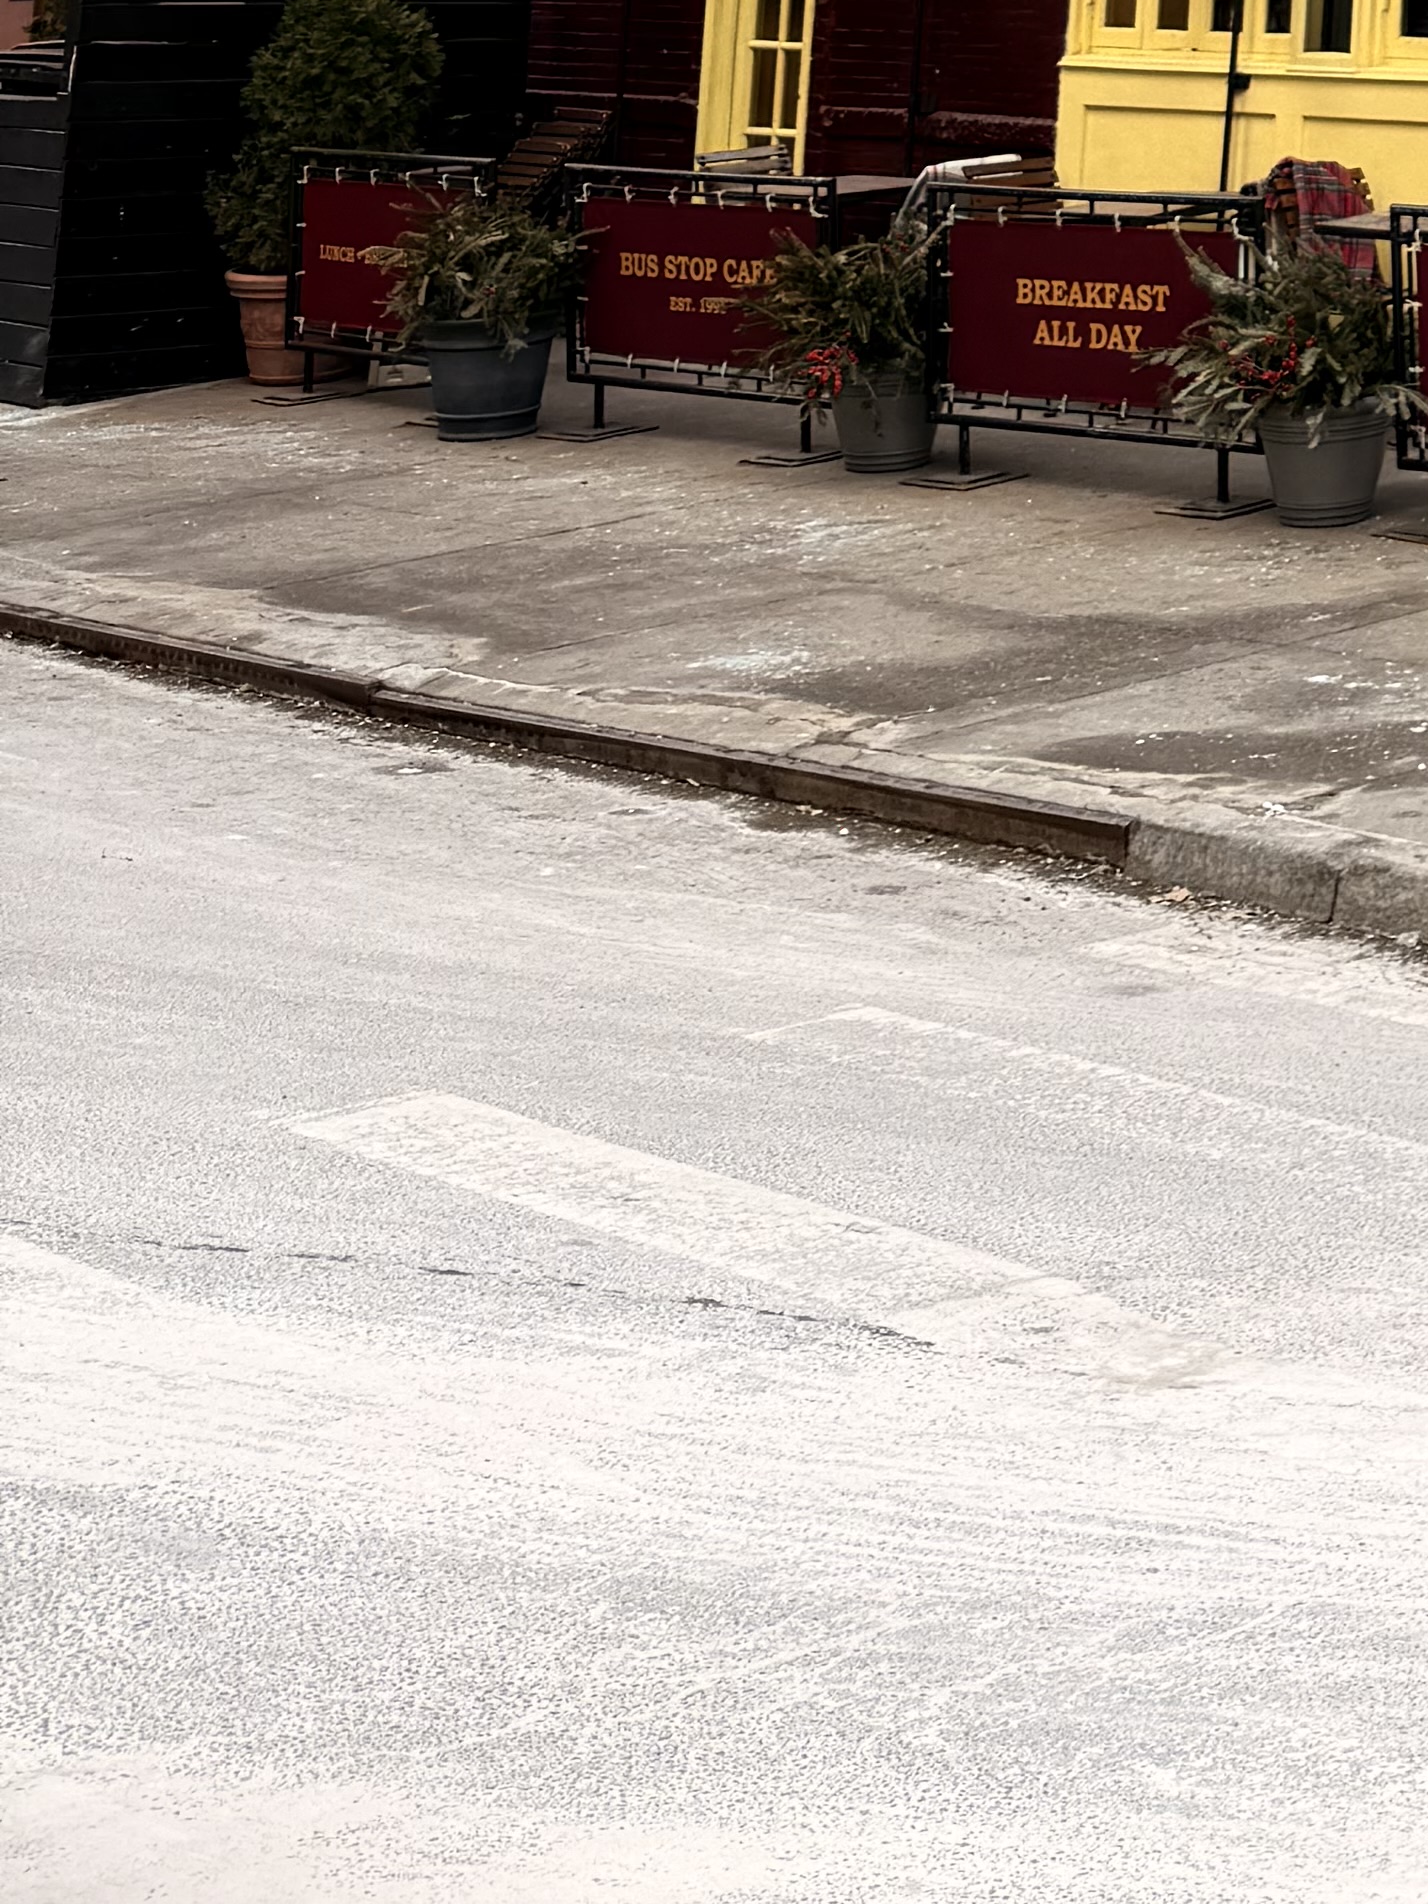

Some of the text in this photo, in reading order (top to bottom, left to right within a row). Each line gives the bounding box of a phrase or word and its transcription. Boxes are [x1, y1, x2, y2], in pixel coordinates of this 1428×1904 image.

[319, 244, 355, 263] LUNCH
[619, 252, 659, 278] BUS
[664, 255, 718, 282] STOP
[669, 296, 696, 312] EST.
[1016, 278, 1170, 312] BREAKFAST
[1033, 320, 1143, 353] ALL DAY
